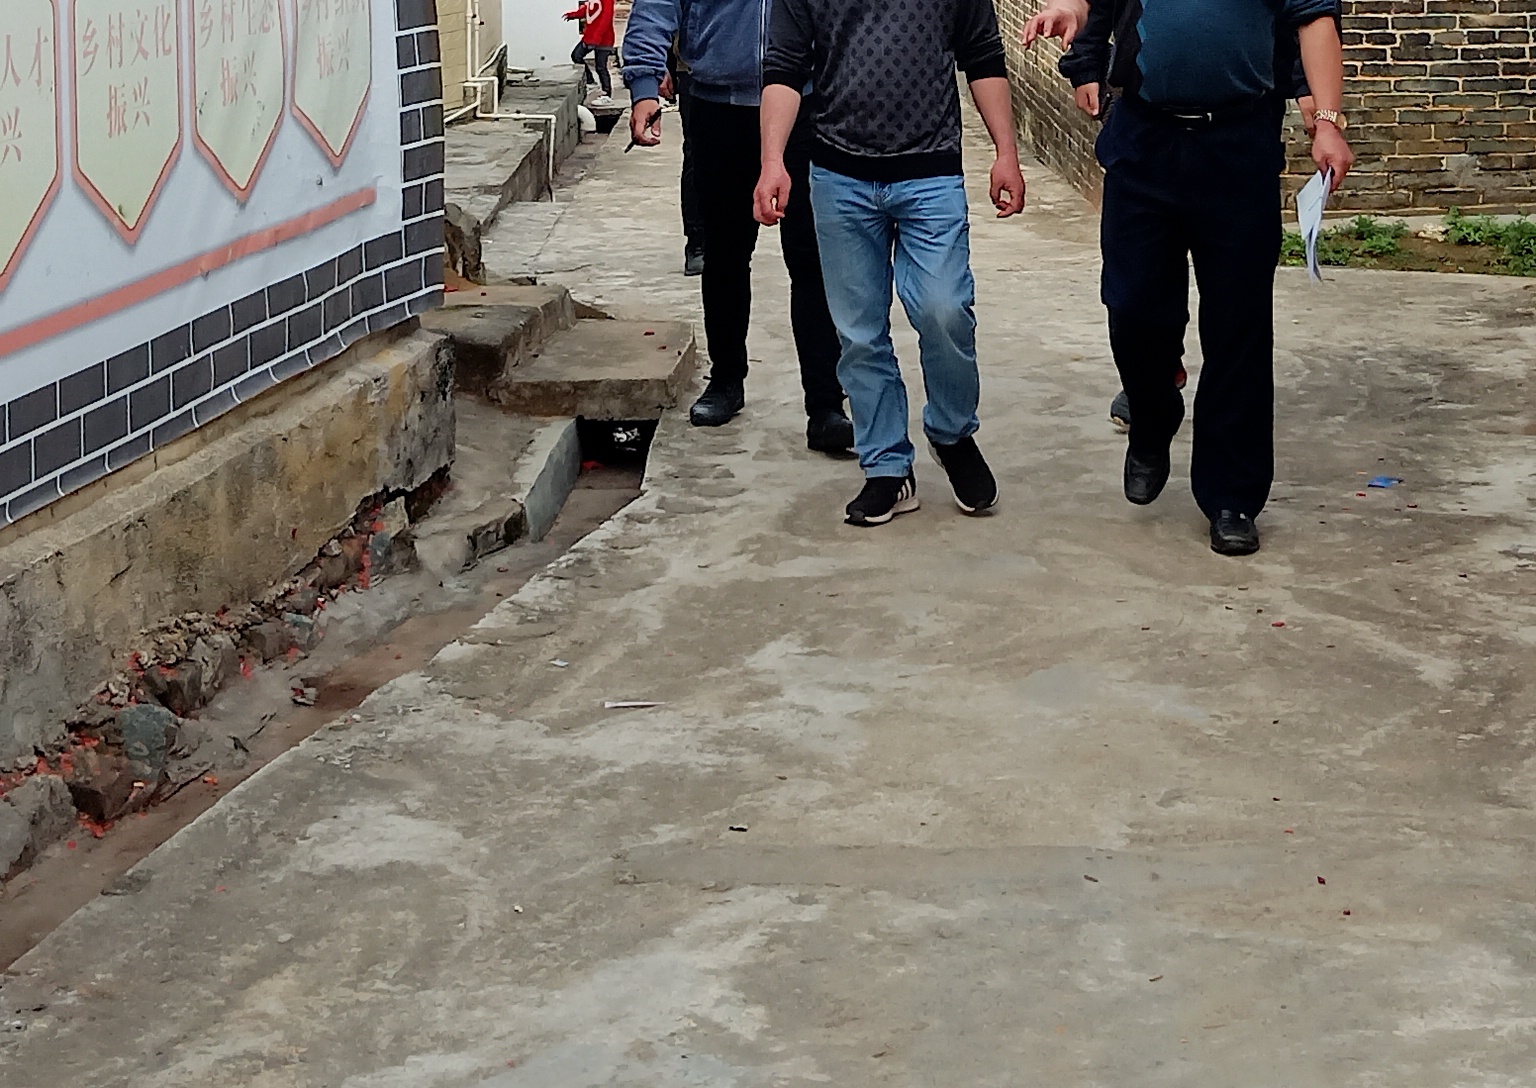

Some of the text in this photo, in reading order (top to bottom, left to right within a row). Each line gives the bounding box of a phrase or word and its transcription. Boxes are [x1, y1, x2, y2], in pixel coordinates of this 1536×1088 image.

[81, 4, 173, 77] 乡村文化
[316, 27, 351, 81] 振兴
[106, 75, 151, 140] 振兴
[219, 50, 258, 108] 振兴
